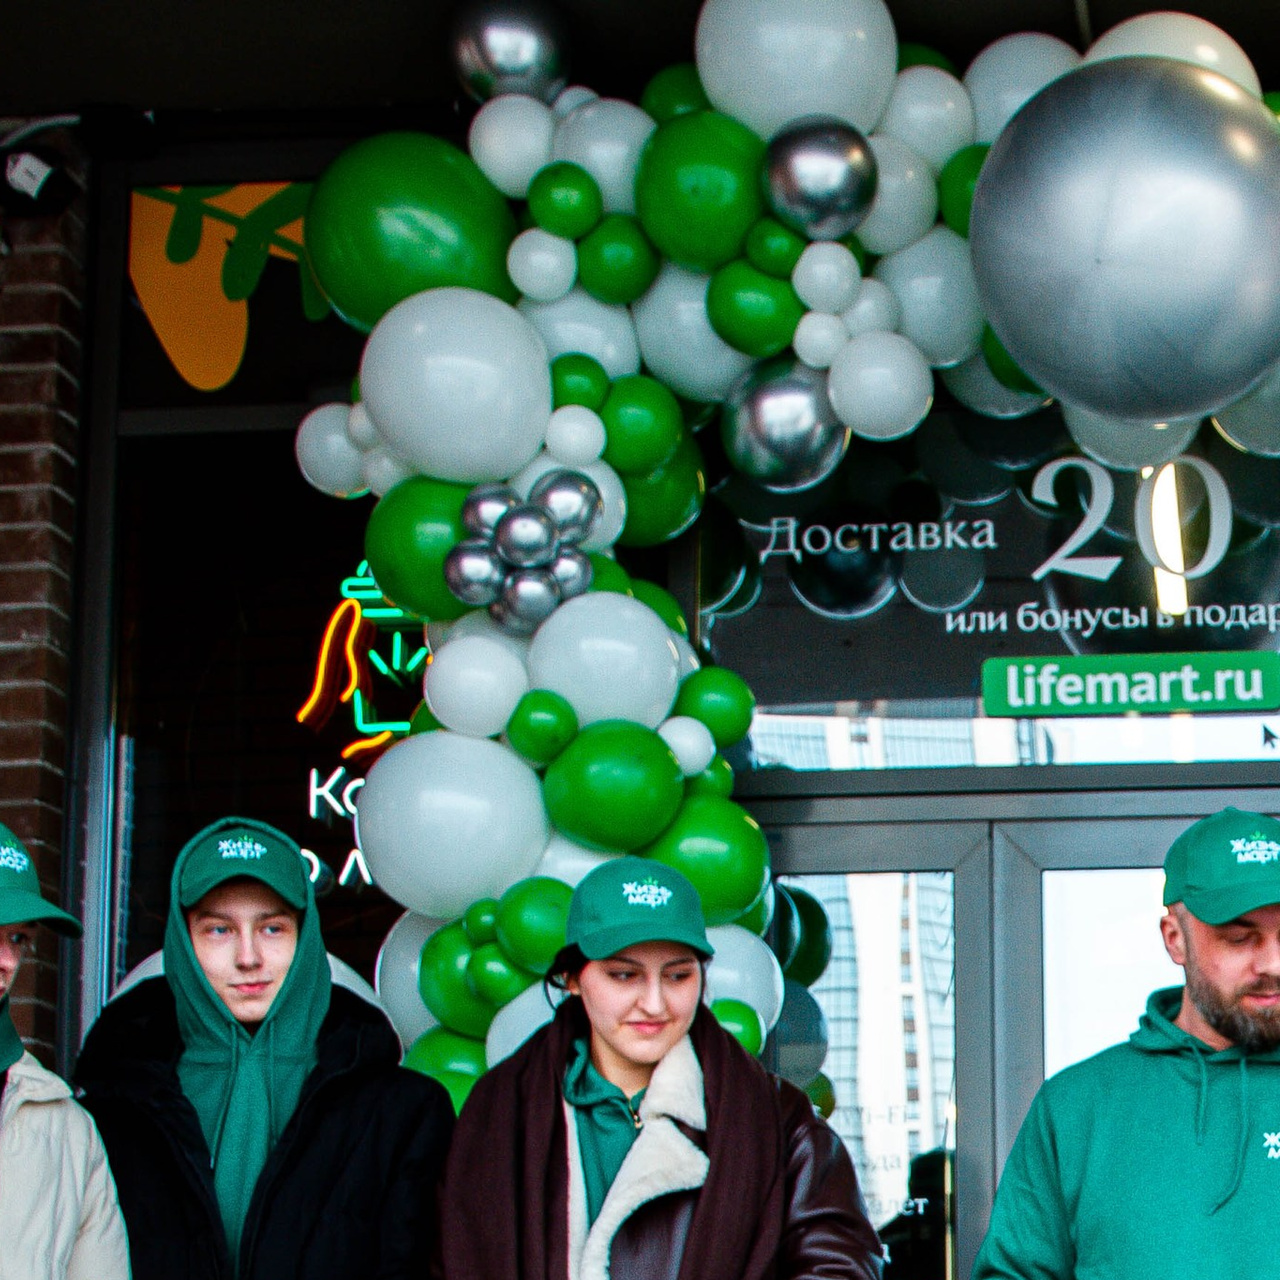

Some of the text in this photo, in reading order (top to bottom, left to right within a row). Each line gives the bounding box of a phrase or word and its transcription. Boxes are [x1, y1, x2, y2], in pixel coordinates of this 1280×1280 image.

[758, 516, 998, 564] Доставка
[1031, 454, 1233, 582] 20
[945, 609, 1008, 634] или
[1016, 601, 1148, 637] бонусы
[1006, 663, 1265, 708] lifemart.ru
